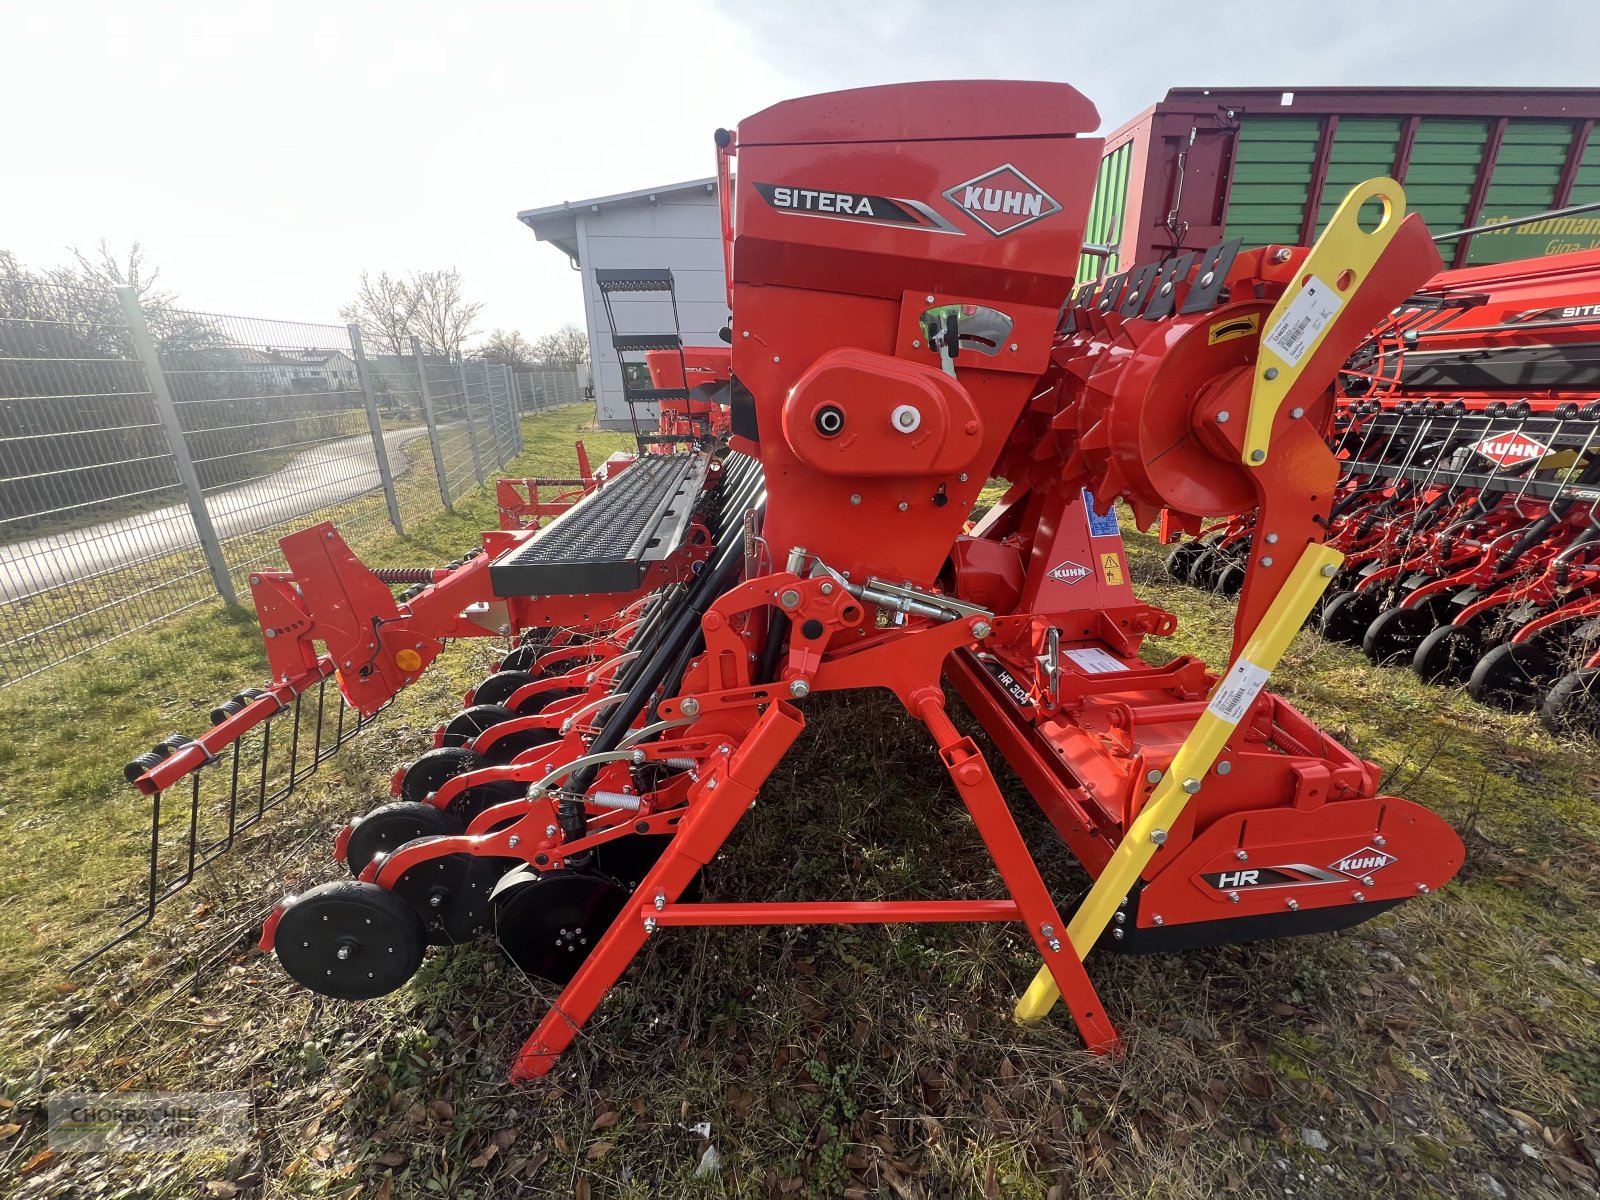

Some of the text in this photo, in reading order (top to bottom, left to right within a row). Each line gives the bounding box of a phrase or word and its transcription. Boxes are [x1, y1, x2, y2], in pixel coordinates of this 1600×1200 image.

[773, 187, 874, 216] SITERA
[963, 186, 1042, 217] KUHN
[1482, 442, 1539, 457] KUHN
[1054, 567, 1086, 578] KUHN
[998, 671, 1013, 687] HR
[1339, 855, 1388, 872] KUHN
[1218, 869, 1260, 888] HR
